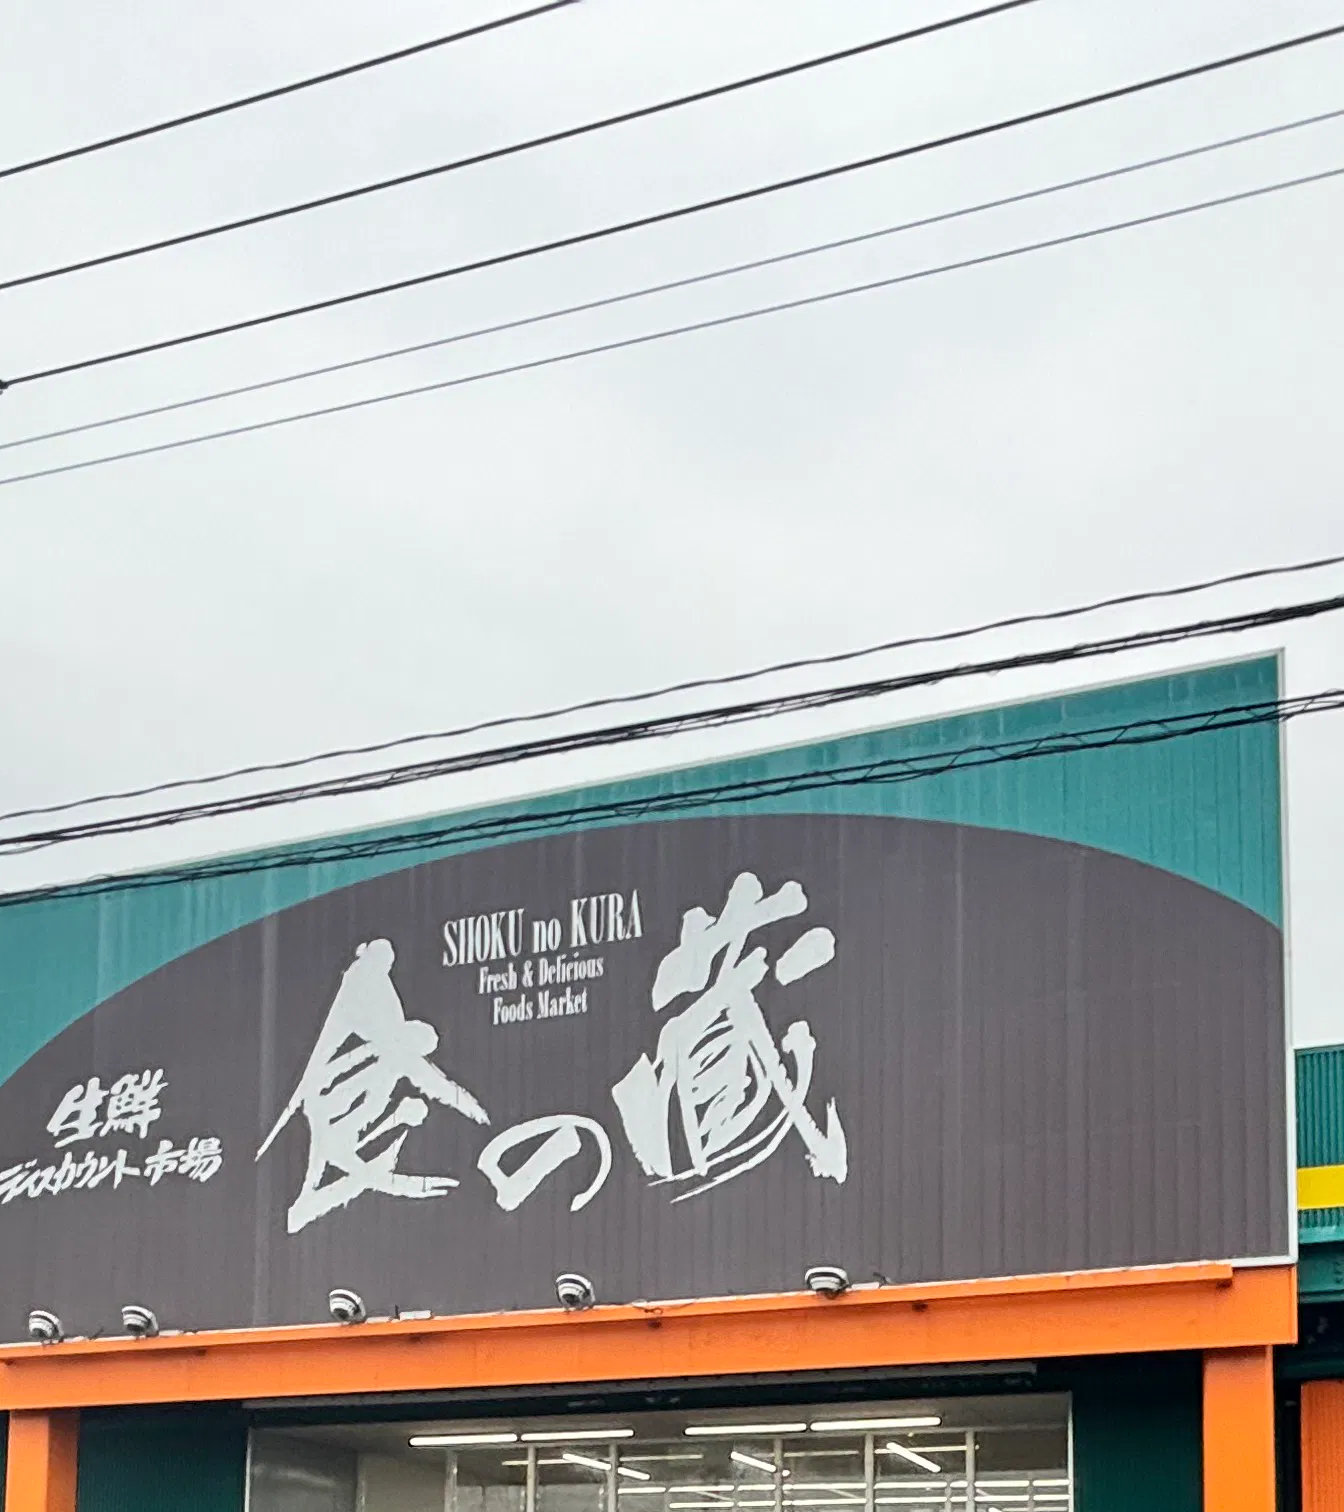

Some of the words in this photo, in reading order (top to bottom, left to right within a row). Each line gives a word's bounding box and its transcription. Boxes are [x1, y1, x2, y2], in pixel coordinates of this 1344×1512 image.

[442, 908, 525, 967] SHOKU
[533, 918, 562, 954] no
[570, 888, 643, 948] KURA
[478, 962, 518, 995] Fresh
[522, 960, 534, 988] &
[539, 951, 604, 987] Delicious
[492, 993, 534, 1026] Foods
[536, 986, 588, 1020] Market
[255, 871, 848, 1234] 食の蔵
[46, 1068, 169, 1149] 生鮮
